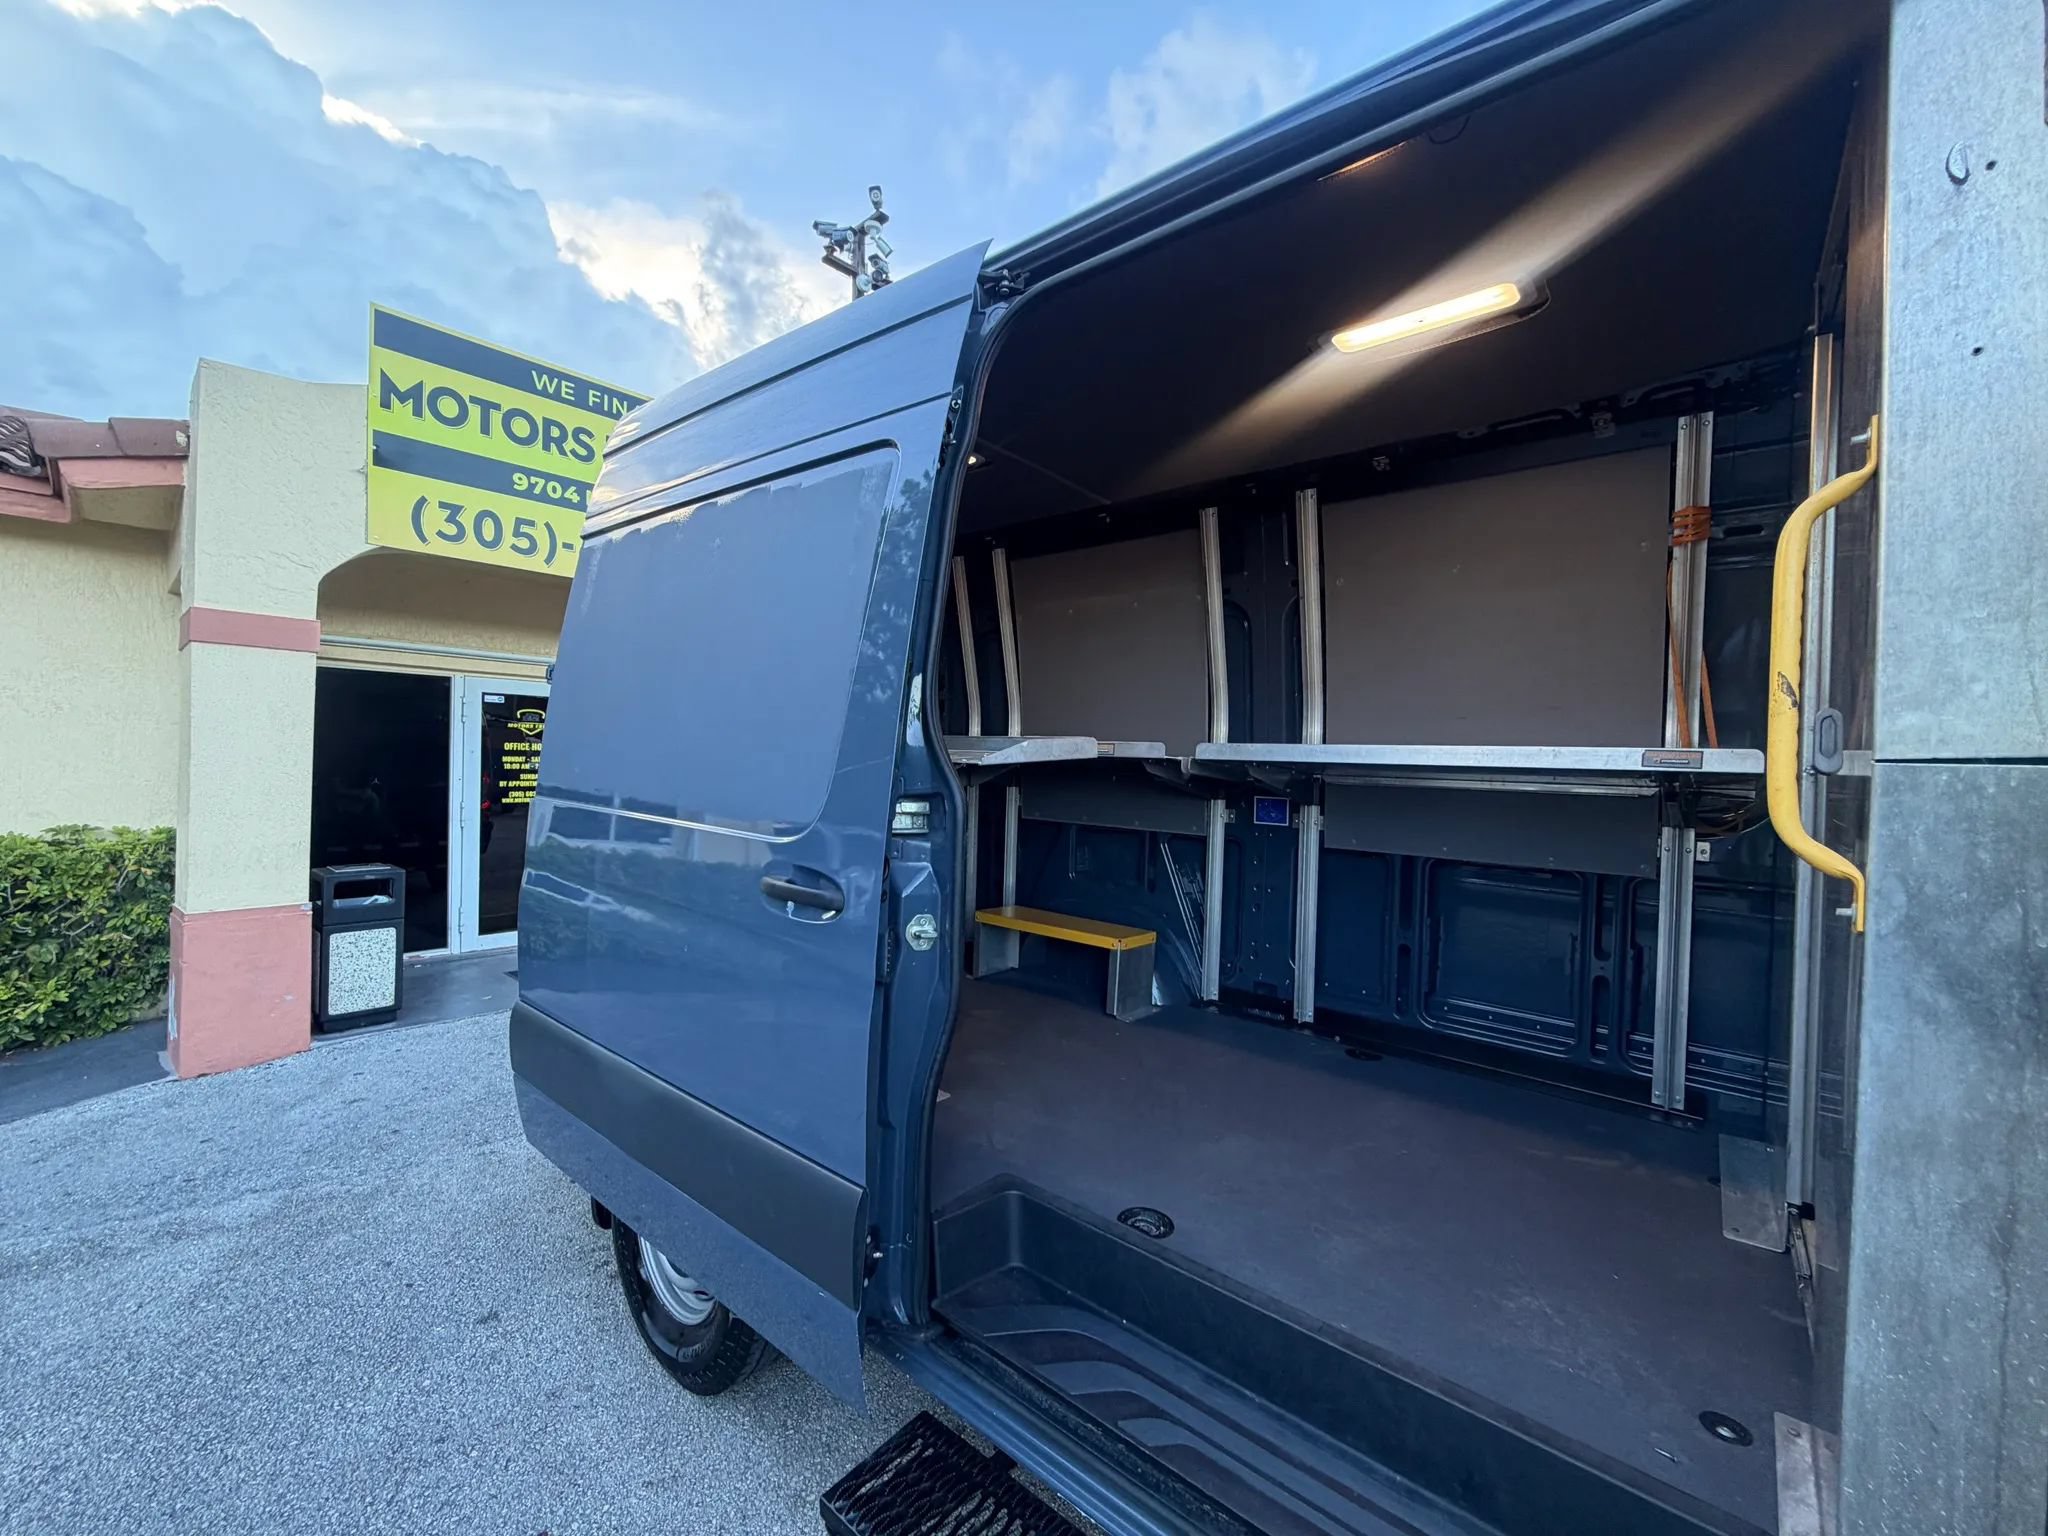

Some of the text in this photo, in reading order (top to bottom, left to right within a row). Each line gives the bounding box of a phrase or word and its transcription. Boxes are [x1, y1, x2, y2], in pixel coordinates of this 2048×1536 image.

[379, 367, 596, 464] MOTORS
[531, 369, 641, 418] WE FIN
[511, 471, 581, 504] 9704
[410, 495, 576, 568] (305)-
[504, 742, 530, 750] OFFICE
